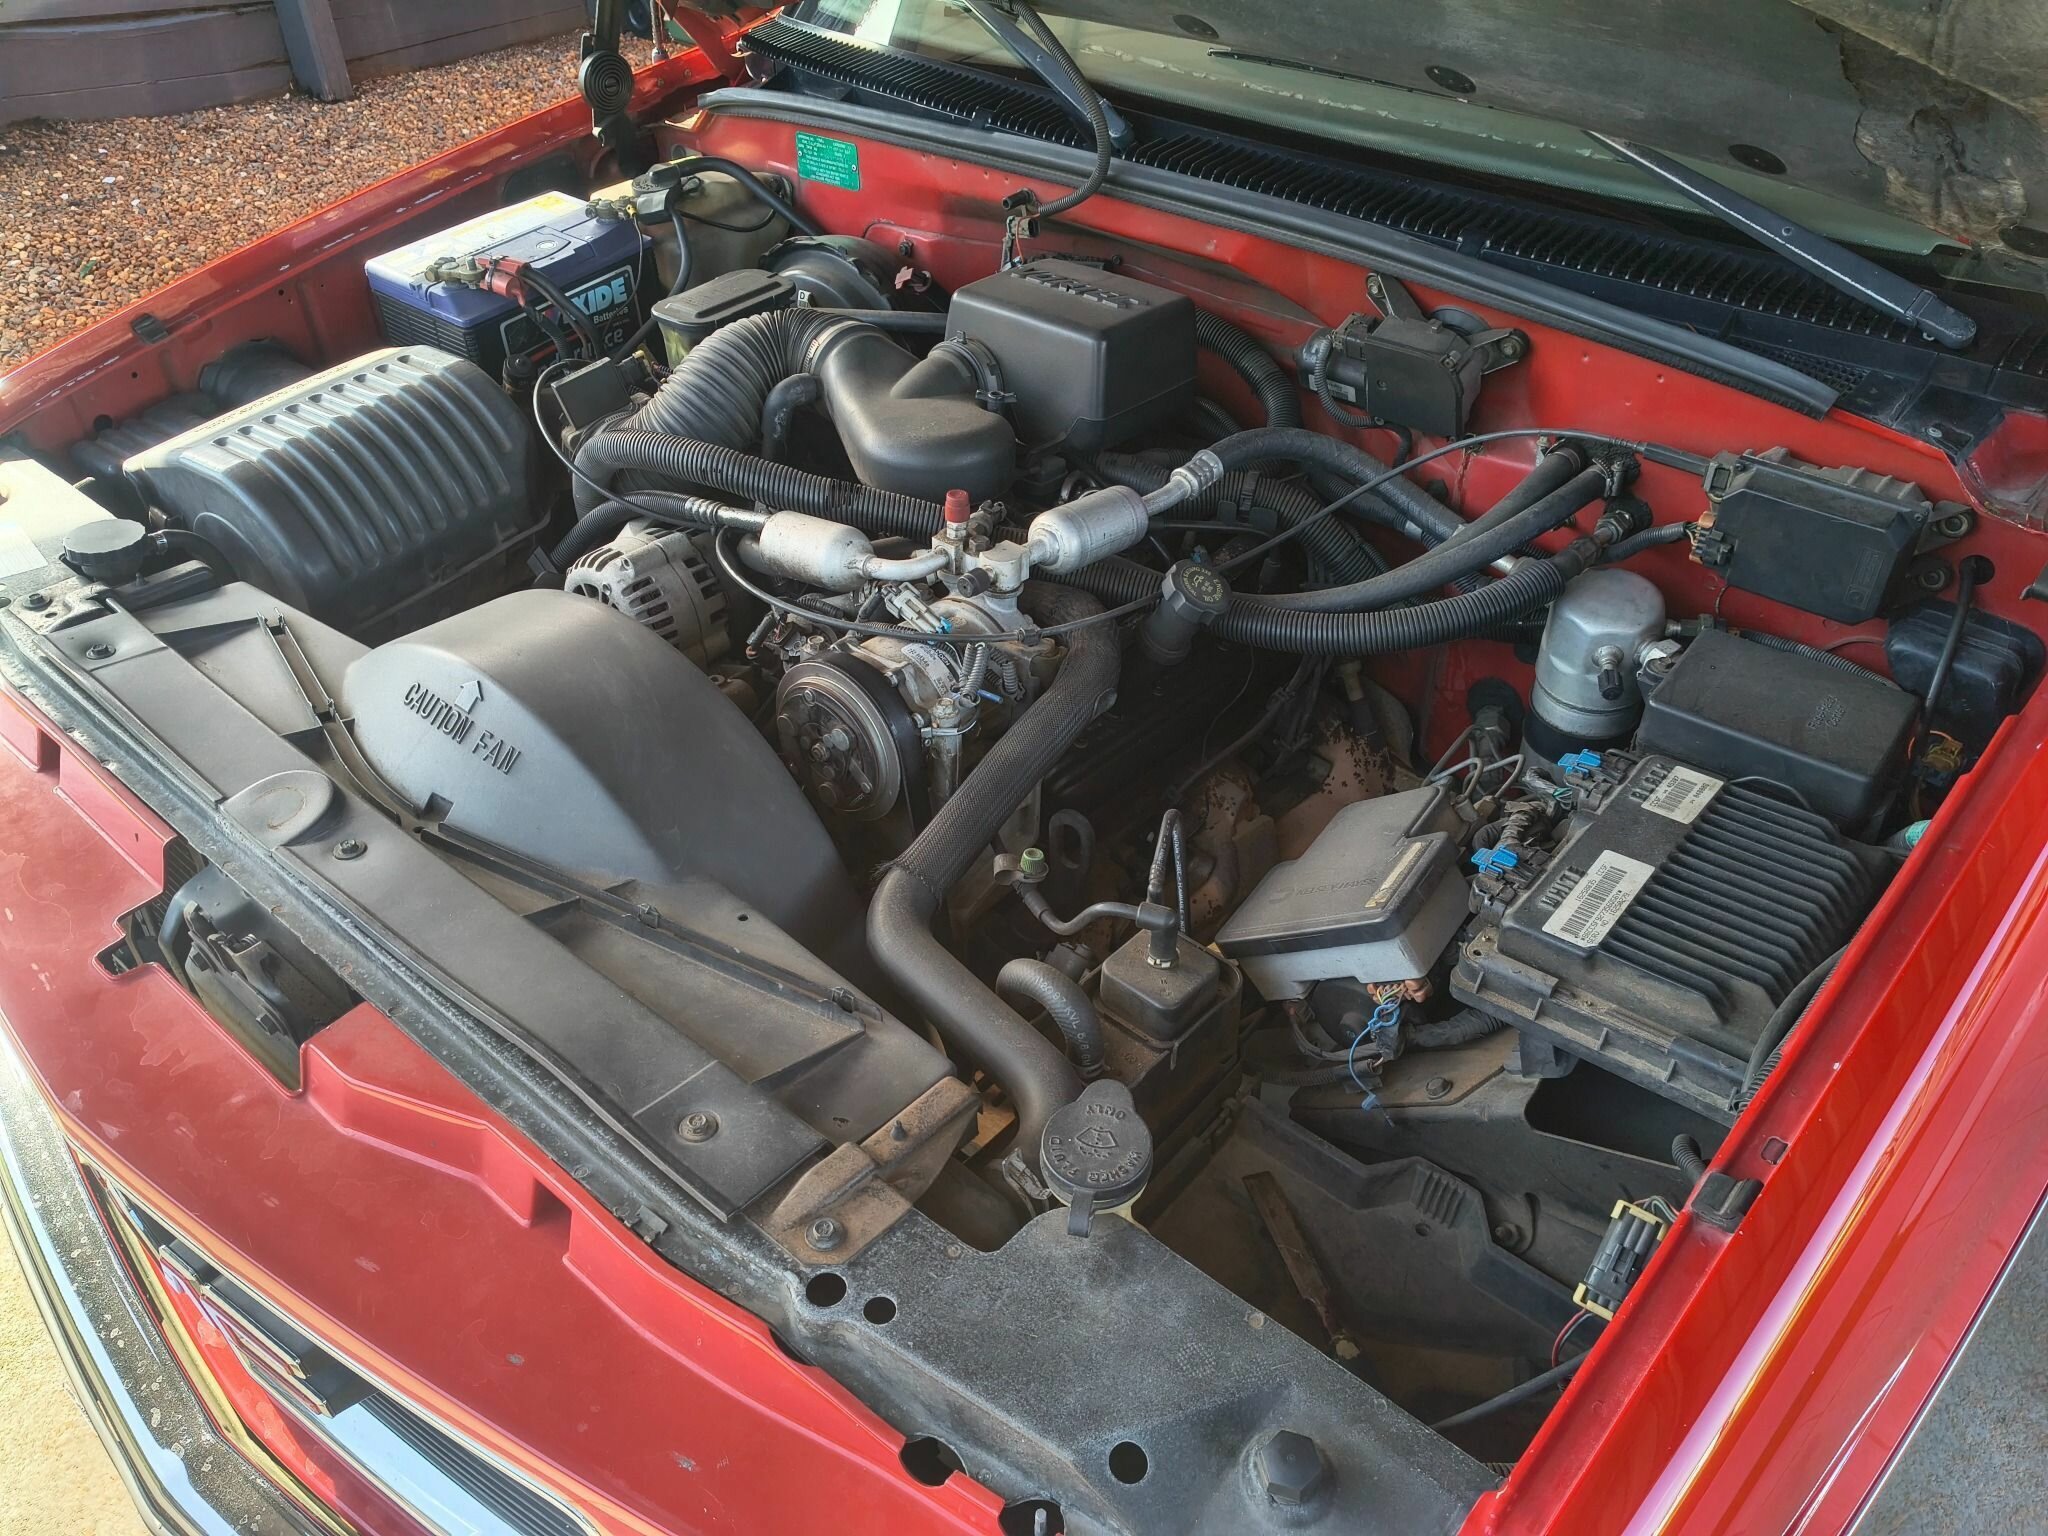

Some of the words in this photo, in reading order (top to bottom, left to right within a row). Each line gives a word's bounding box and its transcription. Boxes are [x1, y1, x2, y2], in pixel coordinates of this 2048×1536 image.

[565, 277, 628, 320] XIDE
[403, 682, 475, 745] CAUTION
[471, 729, 521, 775] FAN
[1065, 1005, 1081, 1029] KVL
[1086, 1103, 1127, 1121] ONLY
[1049, 1136, 1080, 1177] FLUID
[1087, 1150, 1143, 1183] WASHER
